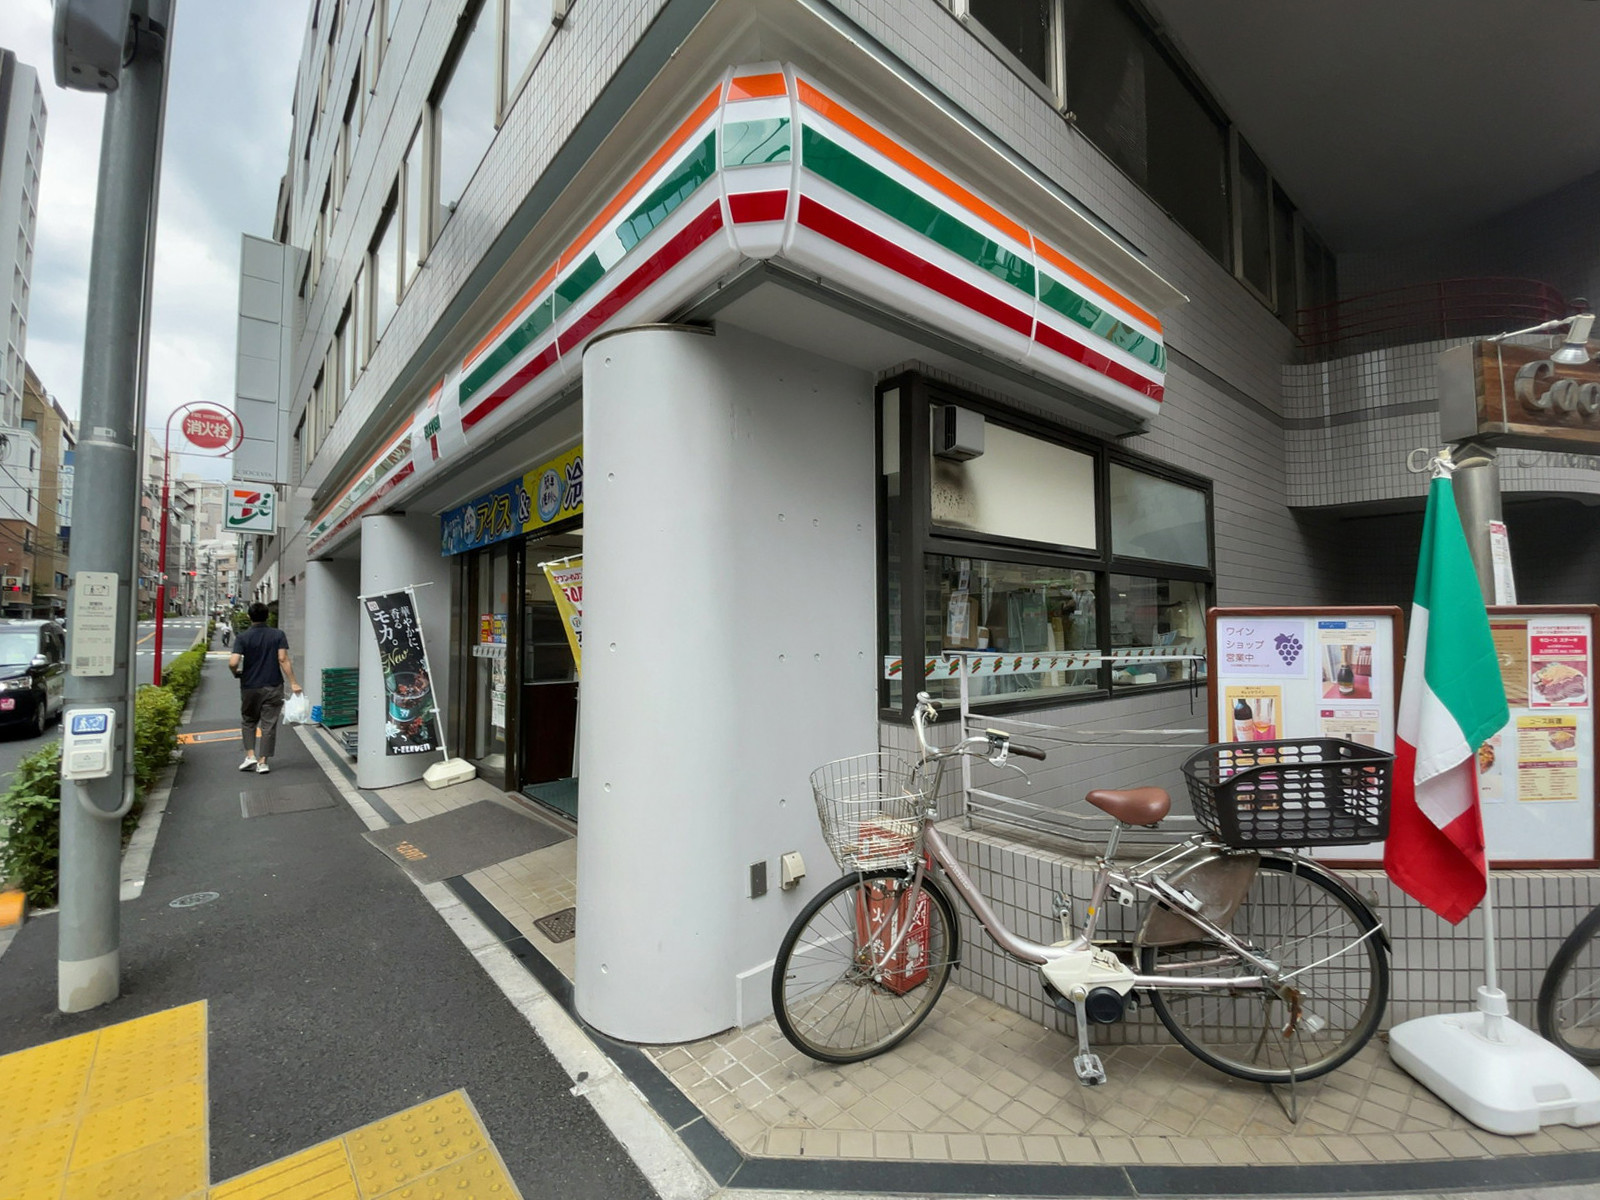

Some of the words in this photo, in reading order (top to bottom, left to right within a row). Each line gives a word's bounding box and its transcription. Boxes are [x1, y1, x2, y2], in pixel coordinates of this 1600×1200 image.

[187, 418, 229, 439] 消火栓
[475, 493, 511, 543] アイス
[517, 487, 532, 524] &
[373, 610, 399, 646] モカ。
[391, 608, 402, 629] 香る
[400, 606, 420, 650] 華やかに、
[1226, 627, 1254, 636] ワイン
[1226, 640, 1264, 649] ショップ
[1226, 653, 1254, 662] 営業中
